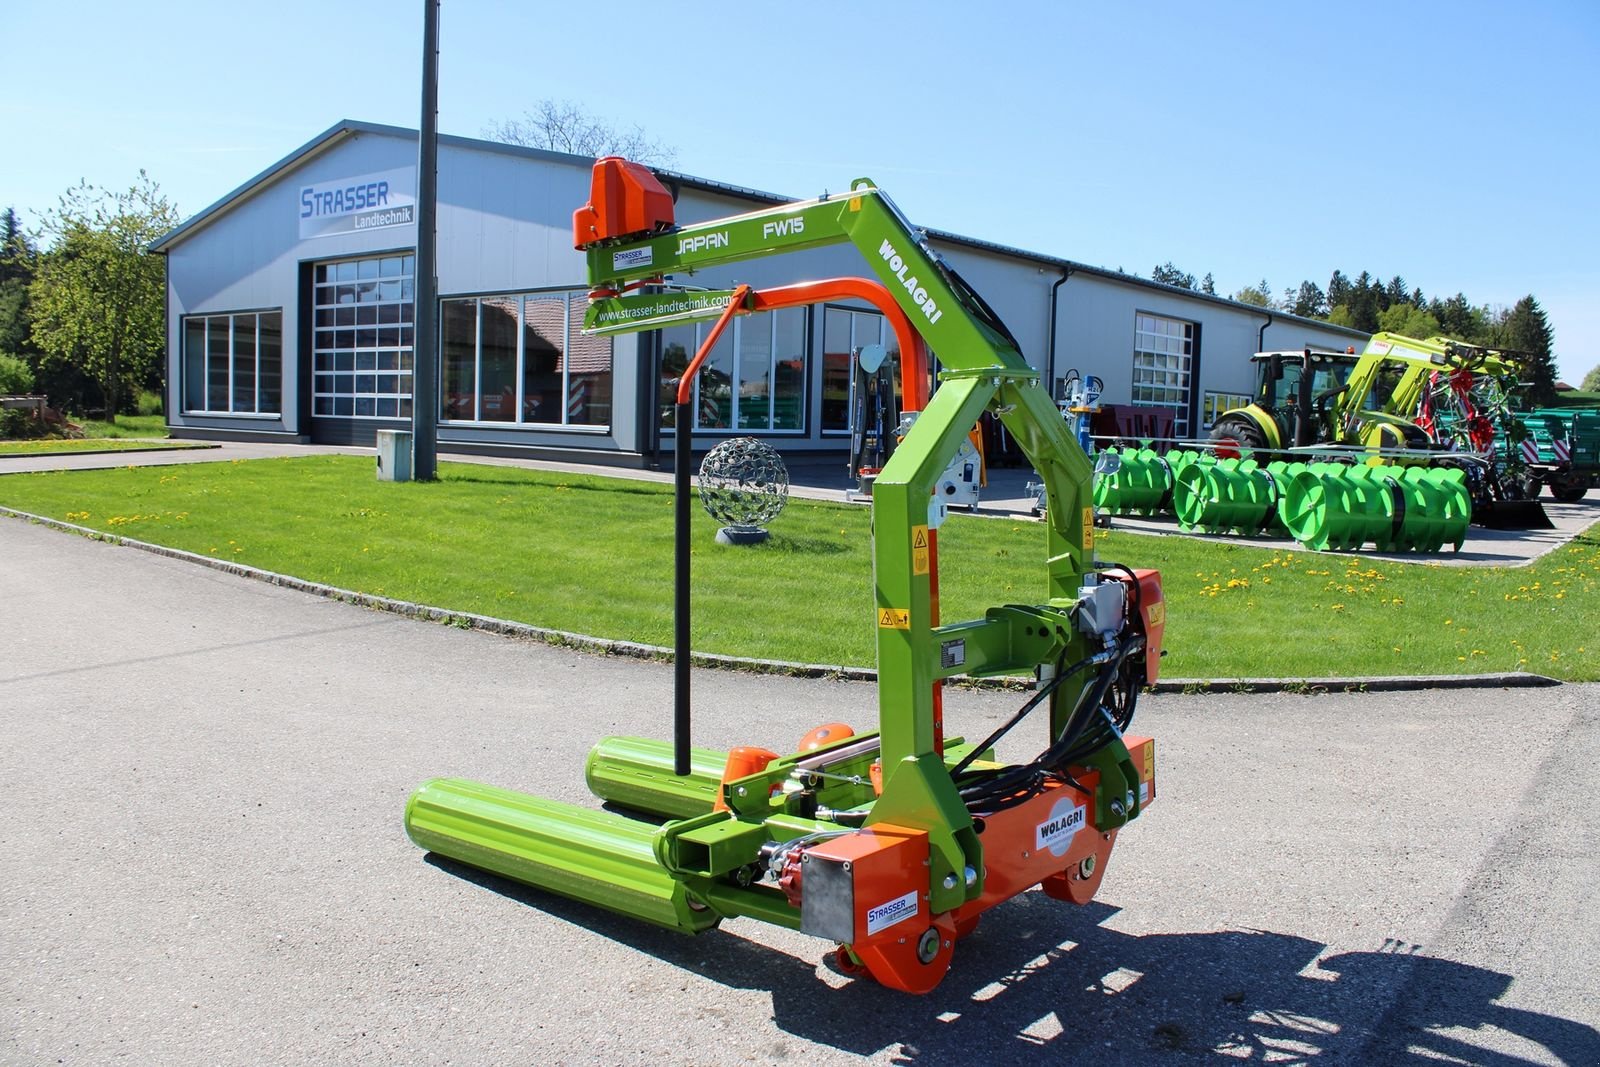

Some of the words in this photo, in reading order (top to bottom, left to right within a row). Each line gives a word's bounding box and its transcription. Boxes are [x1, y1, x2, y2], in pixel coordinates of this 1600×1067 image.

[301, 181, 389, 218] STRASSER
[354, 207, 411, 229] Landtechnik
[763, 216, 805, 240] FW15
[675, 231, 729, 256] JAPAN
[878, 238, 943, 325] WOLAGRI
[599, 294, 733, 321] www.strasser-landtechnik.com
[1040, 809, 1083, 839] WOLAGRI
[869, 899, 906, 923] STRASSER
